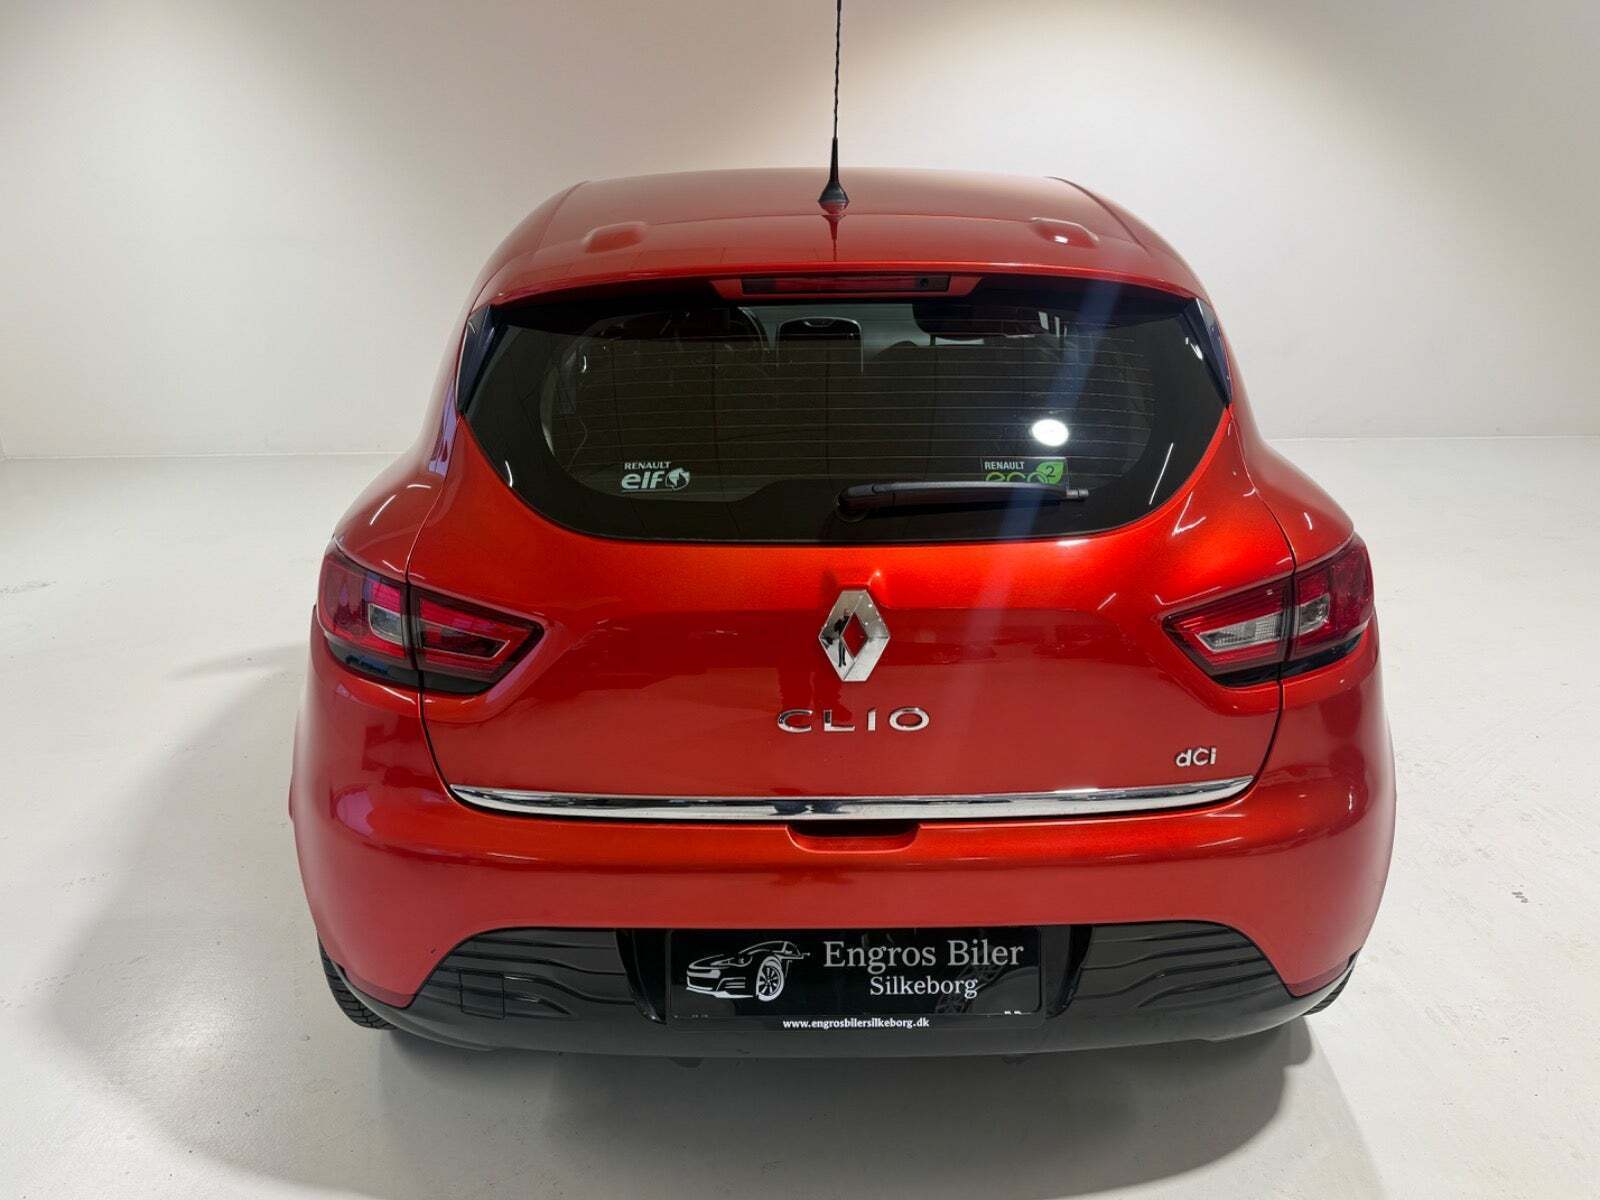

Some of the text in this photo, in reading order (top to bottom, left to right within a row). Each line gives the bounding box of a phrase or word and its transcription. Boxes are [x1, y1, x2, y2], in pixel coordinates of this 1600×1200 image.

[624, 461, 671, 470] RENAULT
[984, 461, 1025, 470] RENAULT
[621, 471, 665, 490] elf
[778, 708, 930, 733] CLIO
[1175, 747, 1217, 767] dCi
[823, 939, 1024, 975] Engros Biler
[869, 975, 979, 999] Silkeborg
[782, 1017, 930, 1030] www.engrosbilersilkeborg.dk
